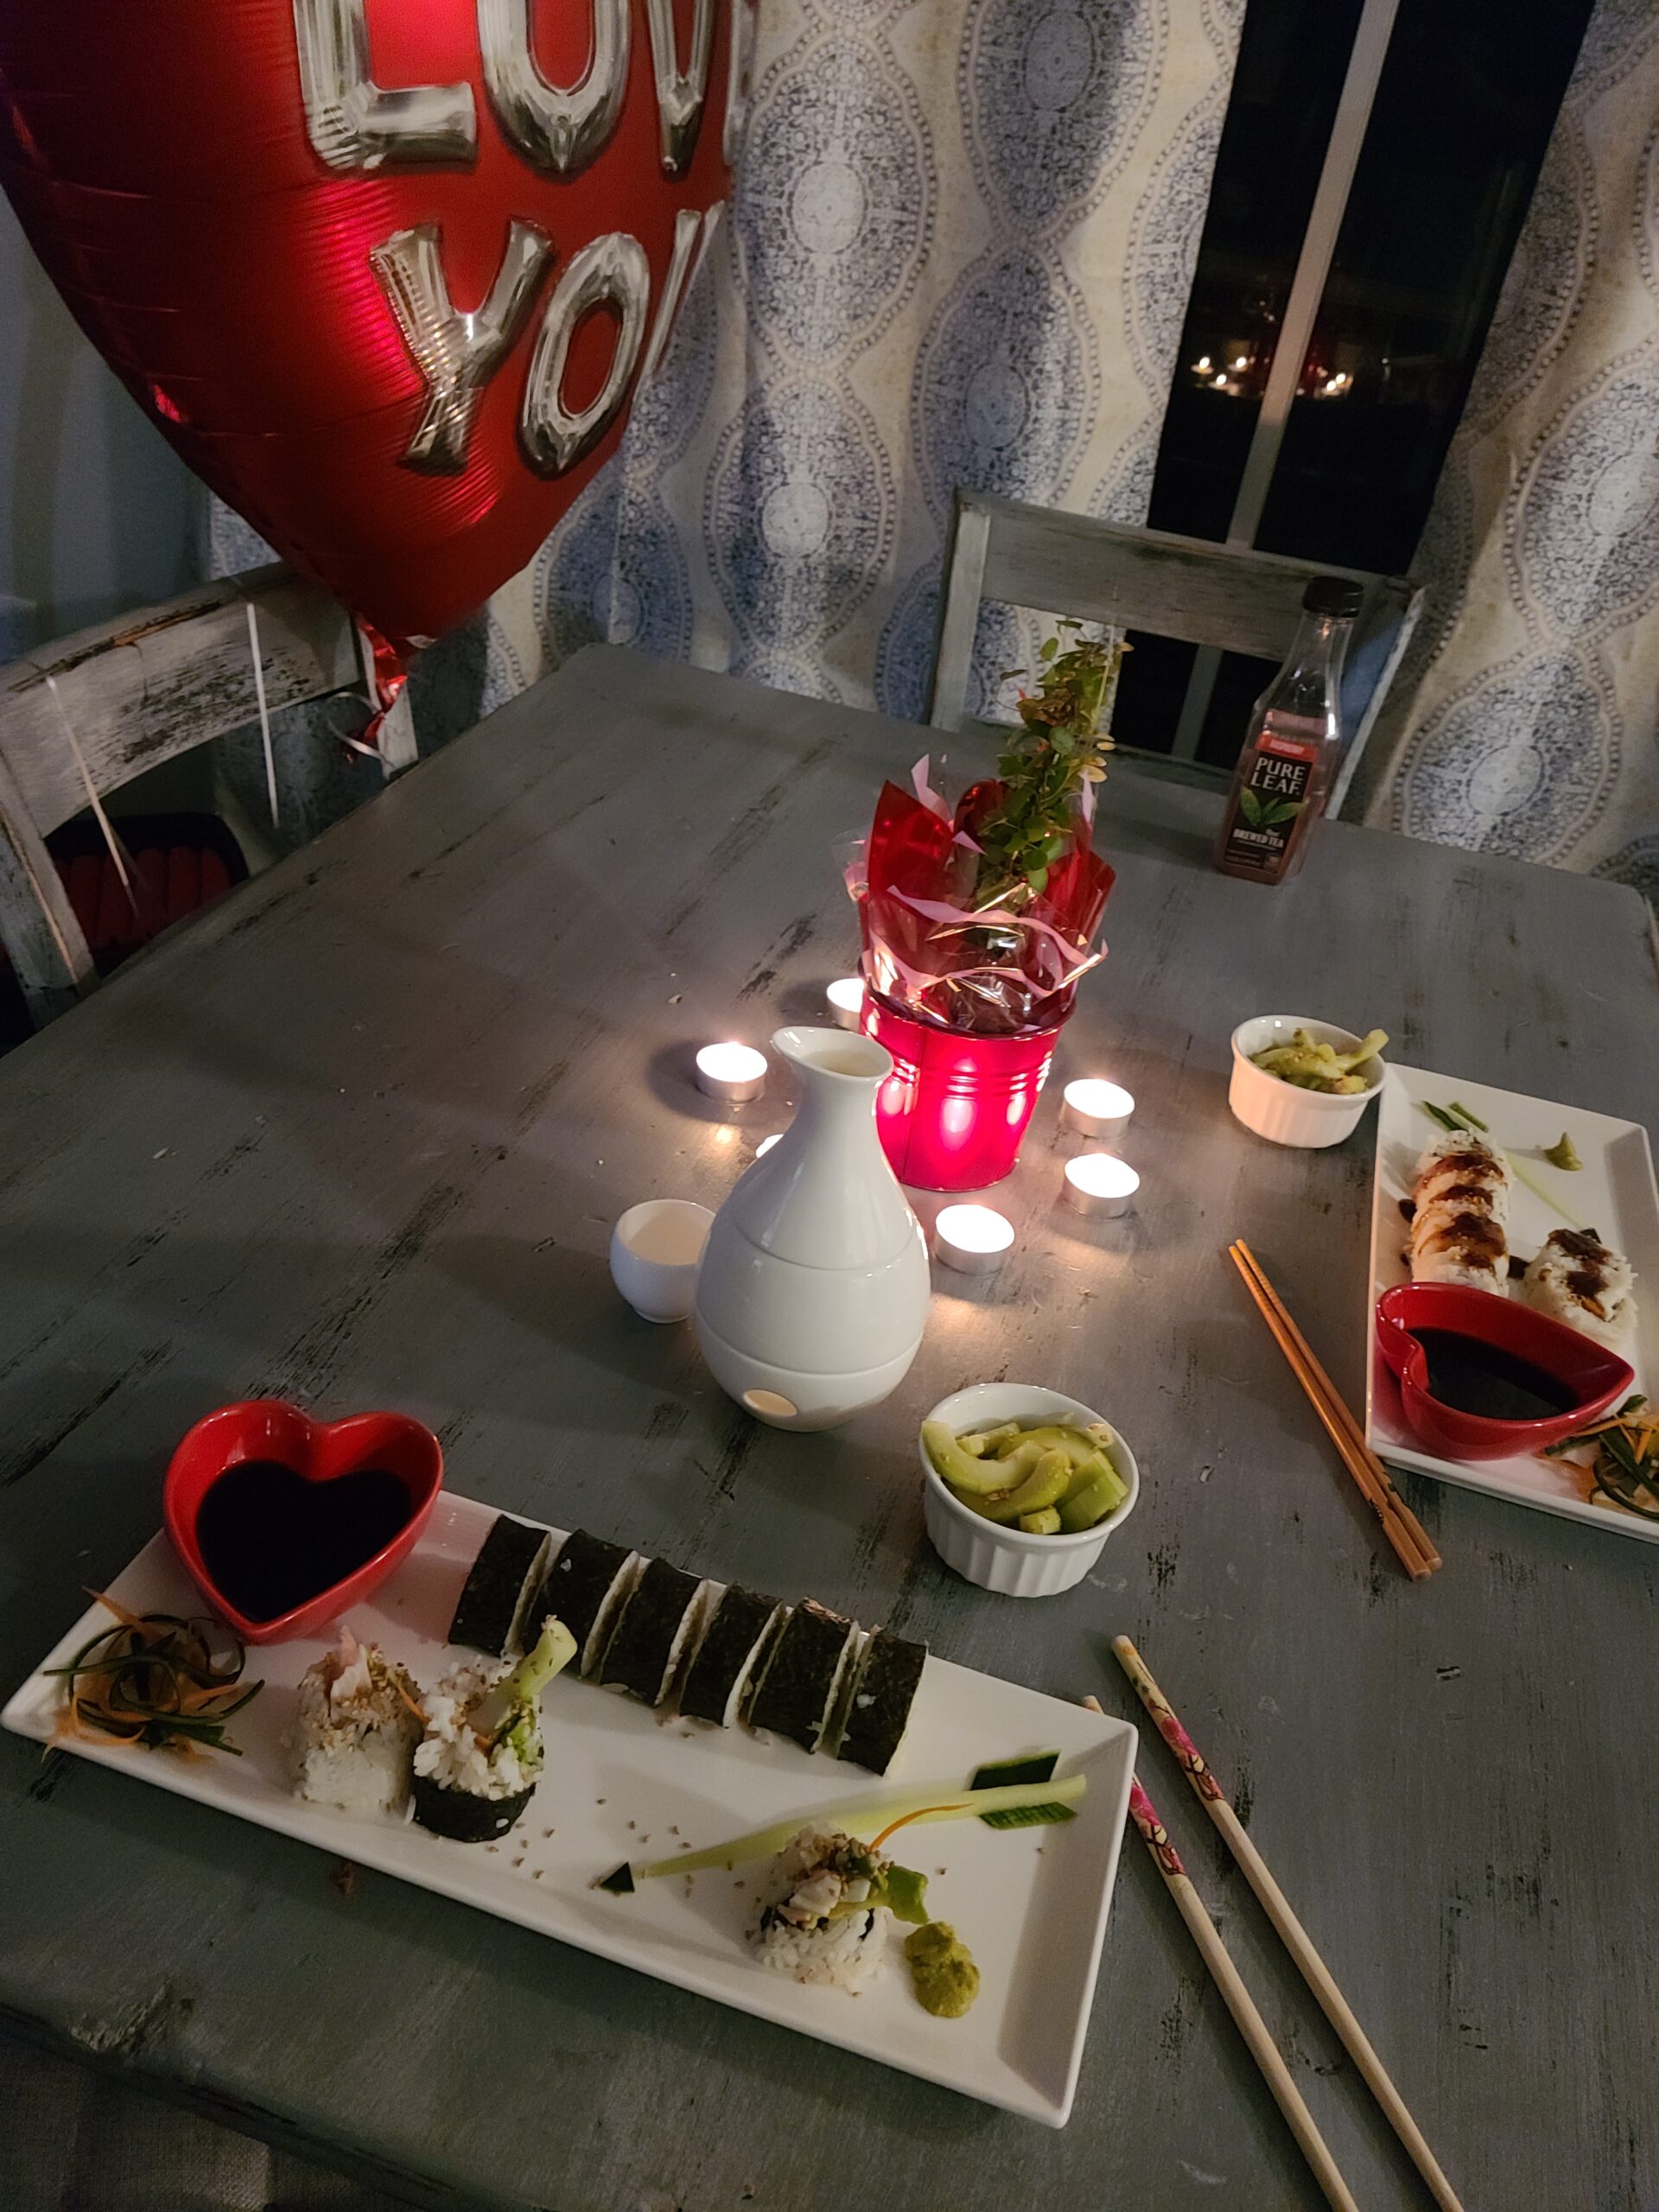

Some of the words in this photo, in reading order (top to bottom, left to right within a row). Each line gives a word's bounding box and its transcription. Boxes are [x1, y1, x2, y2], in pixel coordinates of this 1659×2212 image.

[1255, 757, 1306, 781] PURE
[1250, 771, 1302, 795] LEAF
[1268, 836, 1285, 849] TEA
